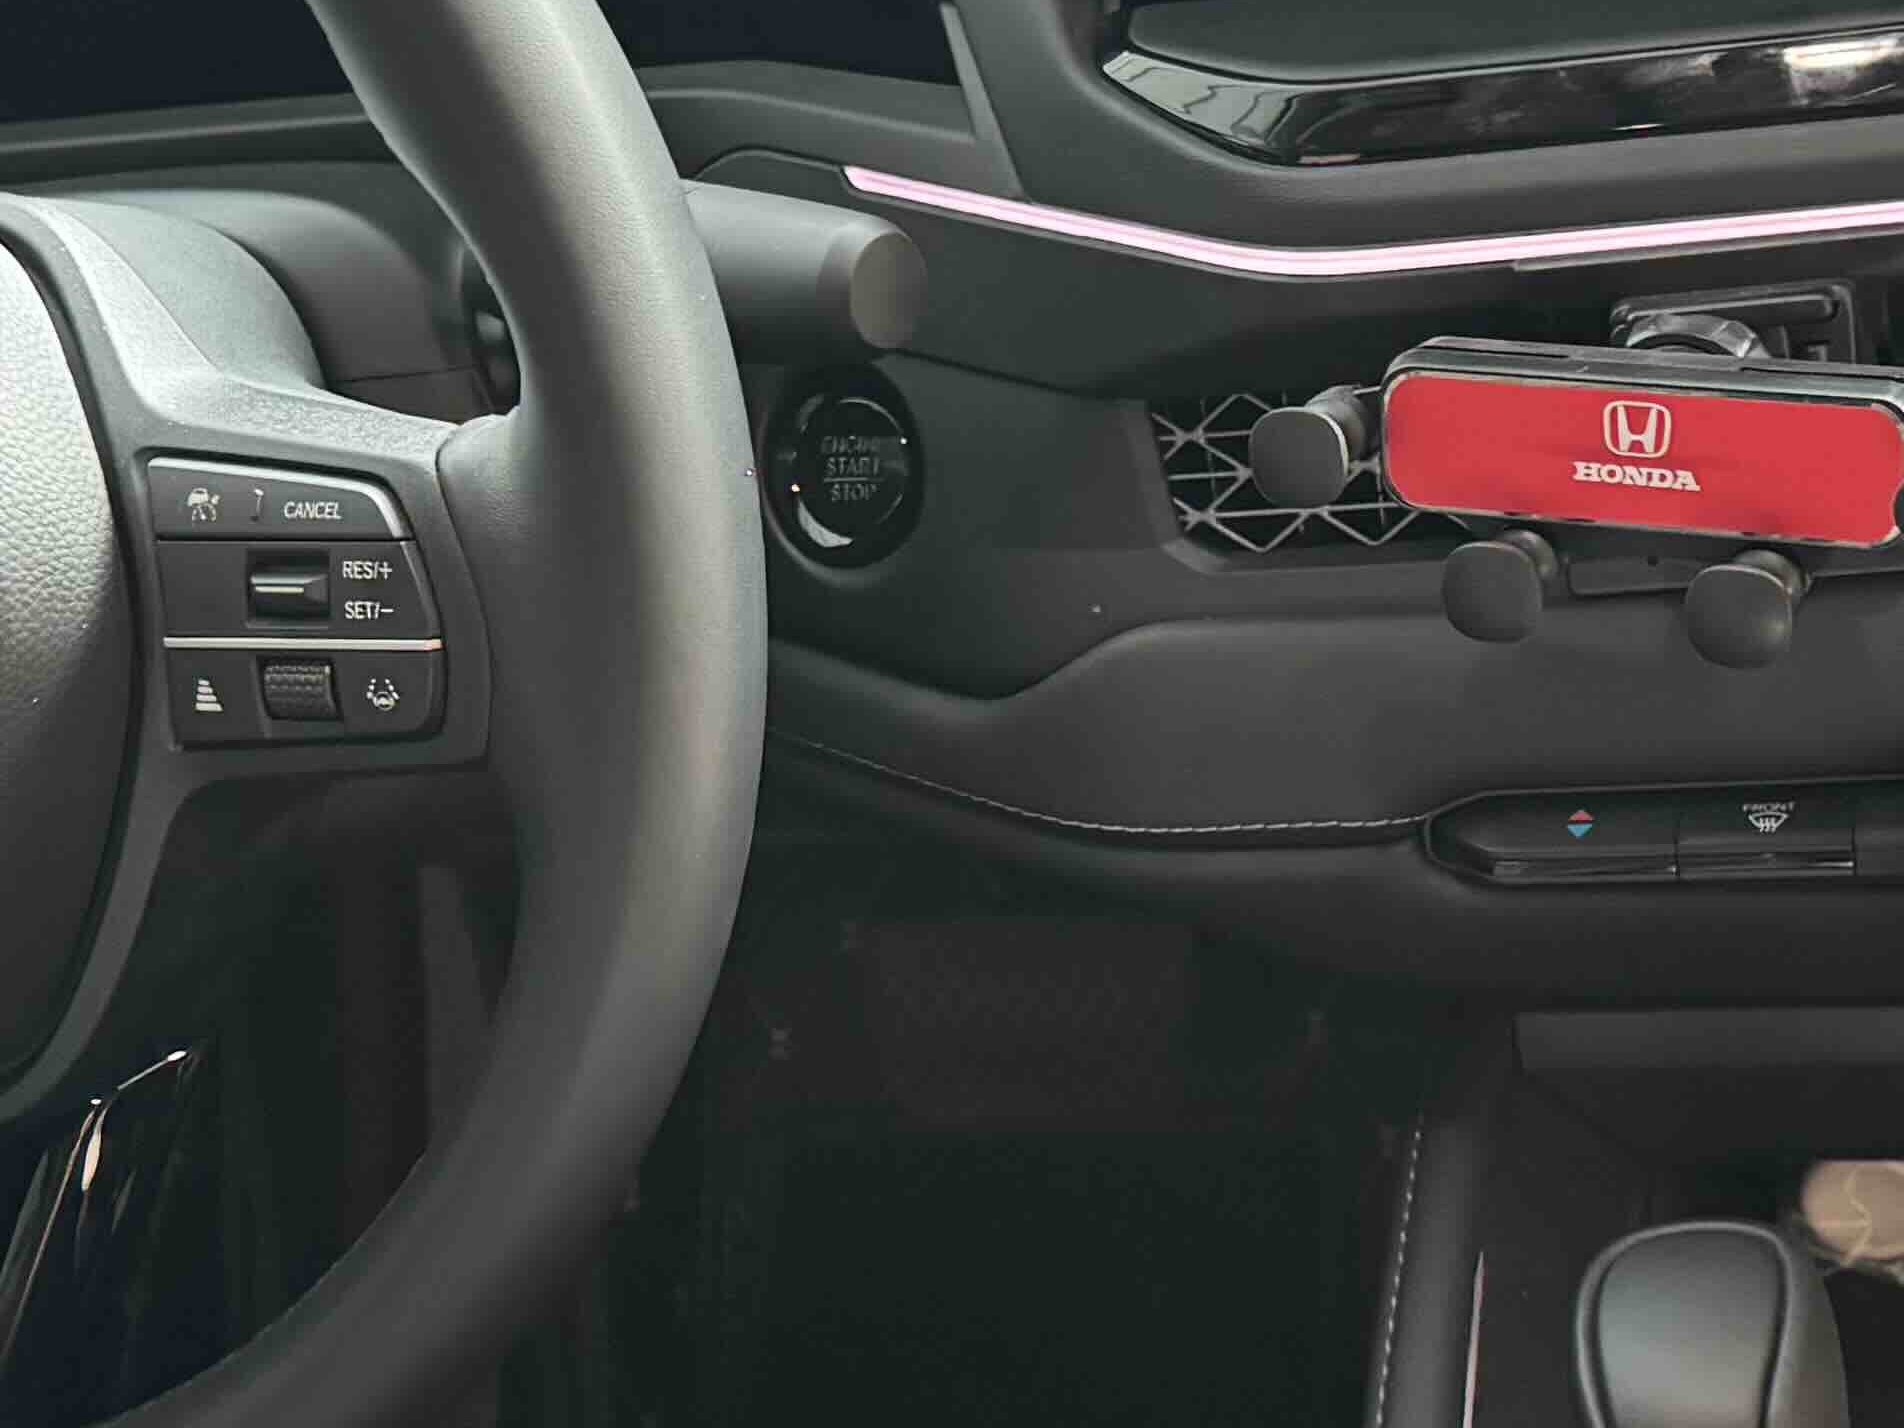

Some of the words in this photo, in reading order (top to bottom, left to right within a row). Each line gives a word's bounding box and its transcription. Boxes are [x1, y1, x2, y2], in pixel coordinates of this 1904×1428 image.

[824, 457, 881, 476] START
[1572, 461, 1701, 493] HONDA
[830, 483, 877, 502] STOP
[283, 501, 343, 521] CANCEL
[342, 560, 393, 580] RES/+
